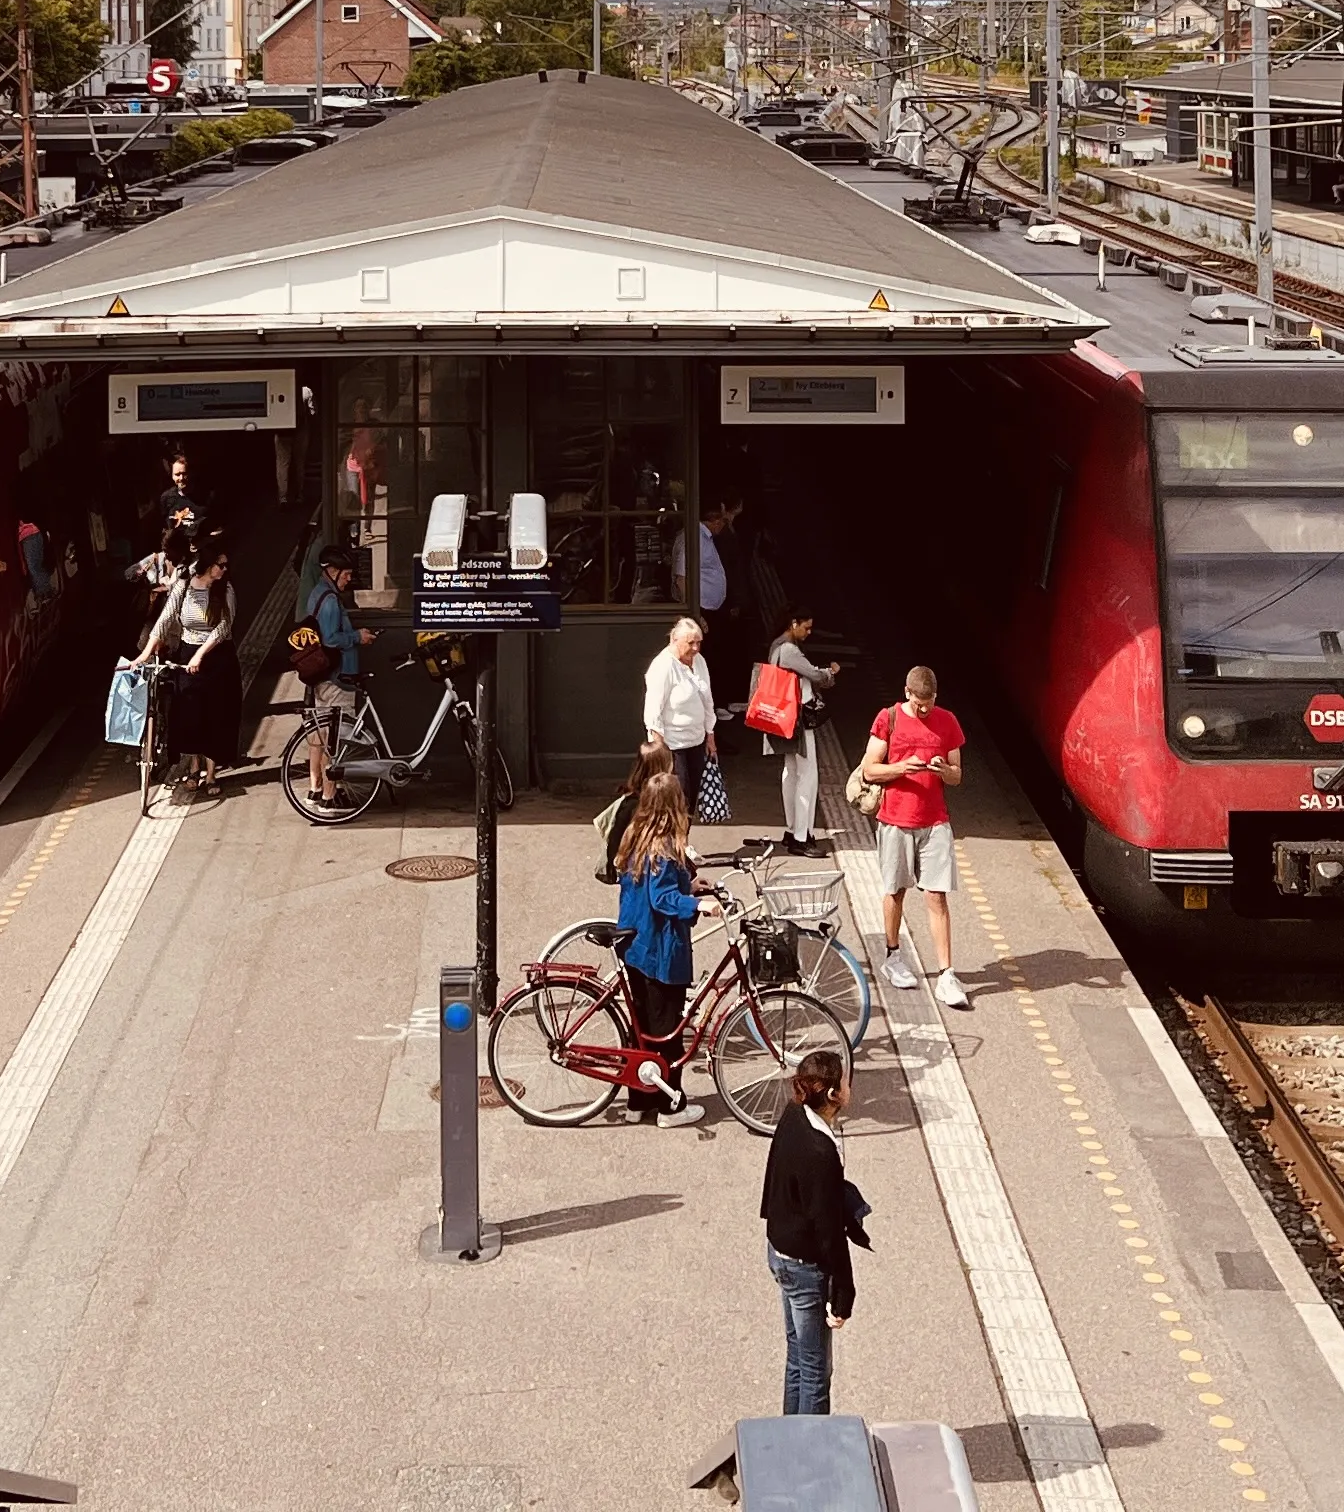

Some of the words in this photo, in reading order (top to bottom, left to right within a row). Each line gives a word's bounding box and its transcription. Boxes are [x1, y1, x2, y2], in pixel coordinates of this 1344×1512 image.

[152, 65, 171, 93] S
[1116, 127, 1125, 137] S
[729, 389, 738, 400] 7
[117, 397, 127, 409] 8
[1299, 794, 1322, 809] SA
